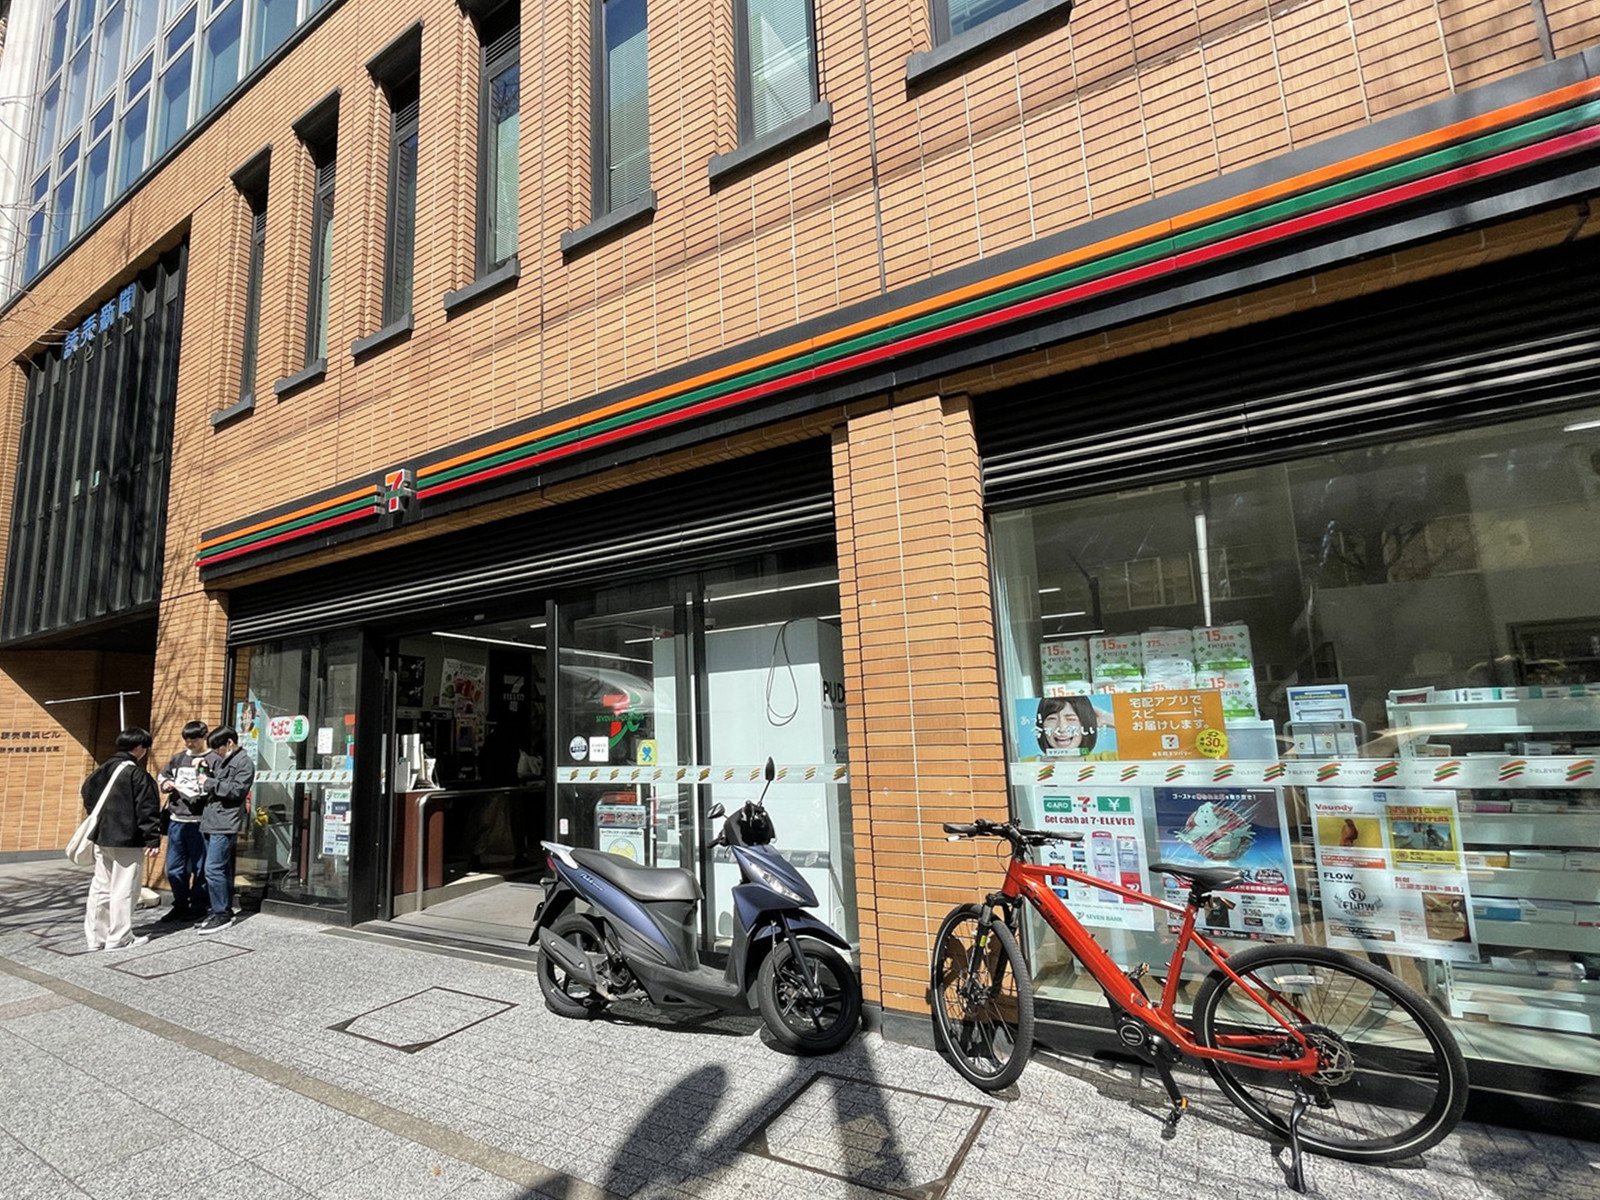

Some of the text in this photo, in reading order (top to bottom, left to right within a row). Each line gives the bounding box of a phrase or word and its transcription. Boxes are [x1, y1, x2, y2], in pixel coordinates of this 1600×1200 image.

[1129, 695, 1202, 708] 宅配アプリで
[1132, 719, 1209, 731] お届けします。
[1315, 803, 1354, 812] Vaundy
[1044, 815, 1059, 823] Get
[1059, 815, 1080, 824] cash
[1323, 872, 1354, 880] FLOW
